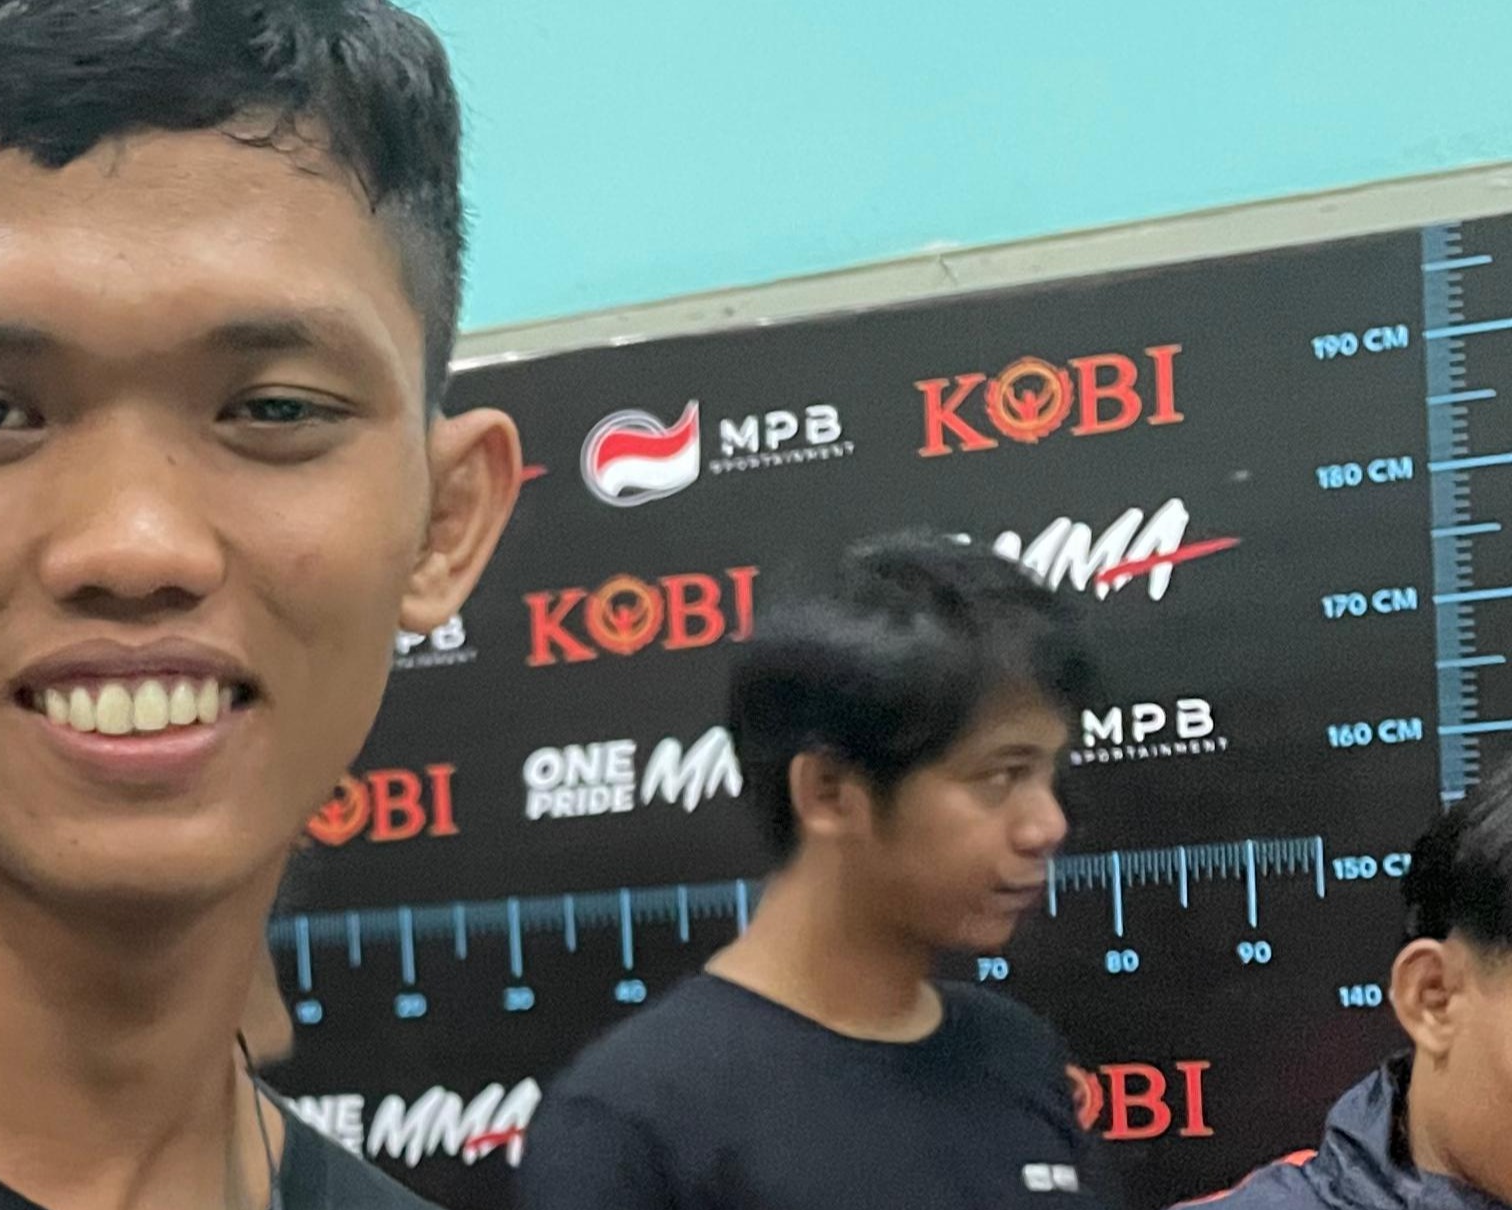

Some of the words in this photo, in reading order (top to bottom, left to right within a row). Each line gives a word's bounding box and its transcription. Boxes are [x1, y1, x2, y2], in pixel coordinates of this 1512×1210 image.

[1311, 332, 1358, 360] 190
[1363, 324, 1409, 352] CM
[915, 344, 1185, 458] KOBI
[720, 404, 842, 457] MPB
[1316, 462, 1363, 489] 180
[1367, 456, 1413, 483] CM
[525, 566, 759, 667] KOBI
[1322, 592, 1367, 618] 170
[1372, 587, 1418, 614] CM
[1082, 698, 1214, 747] MPB
[1328, 722, 1372, 748] 160
[1378, 717, 1423, 744] CM
[523, 739, 637, 791] ONE
[1070, 735, 1228, 766] SPORTAINMENT
[526, 784, 636, 820] PRIDE
[1333, 855, 1378, 880] 150
[1105, 948, 1139, 974] 80
[1237, 940, 1272, 965] 90
[977, 956, 1009, 982] 70
[1338, 984, 1382, 1008] 140
